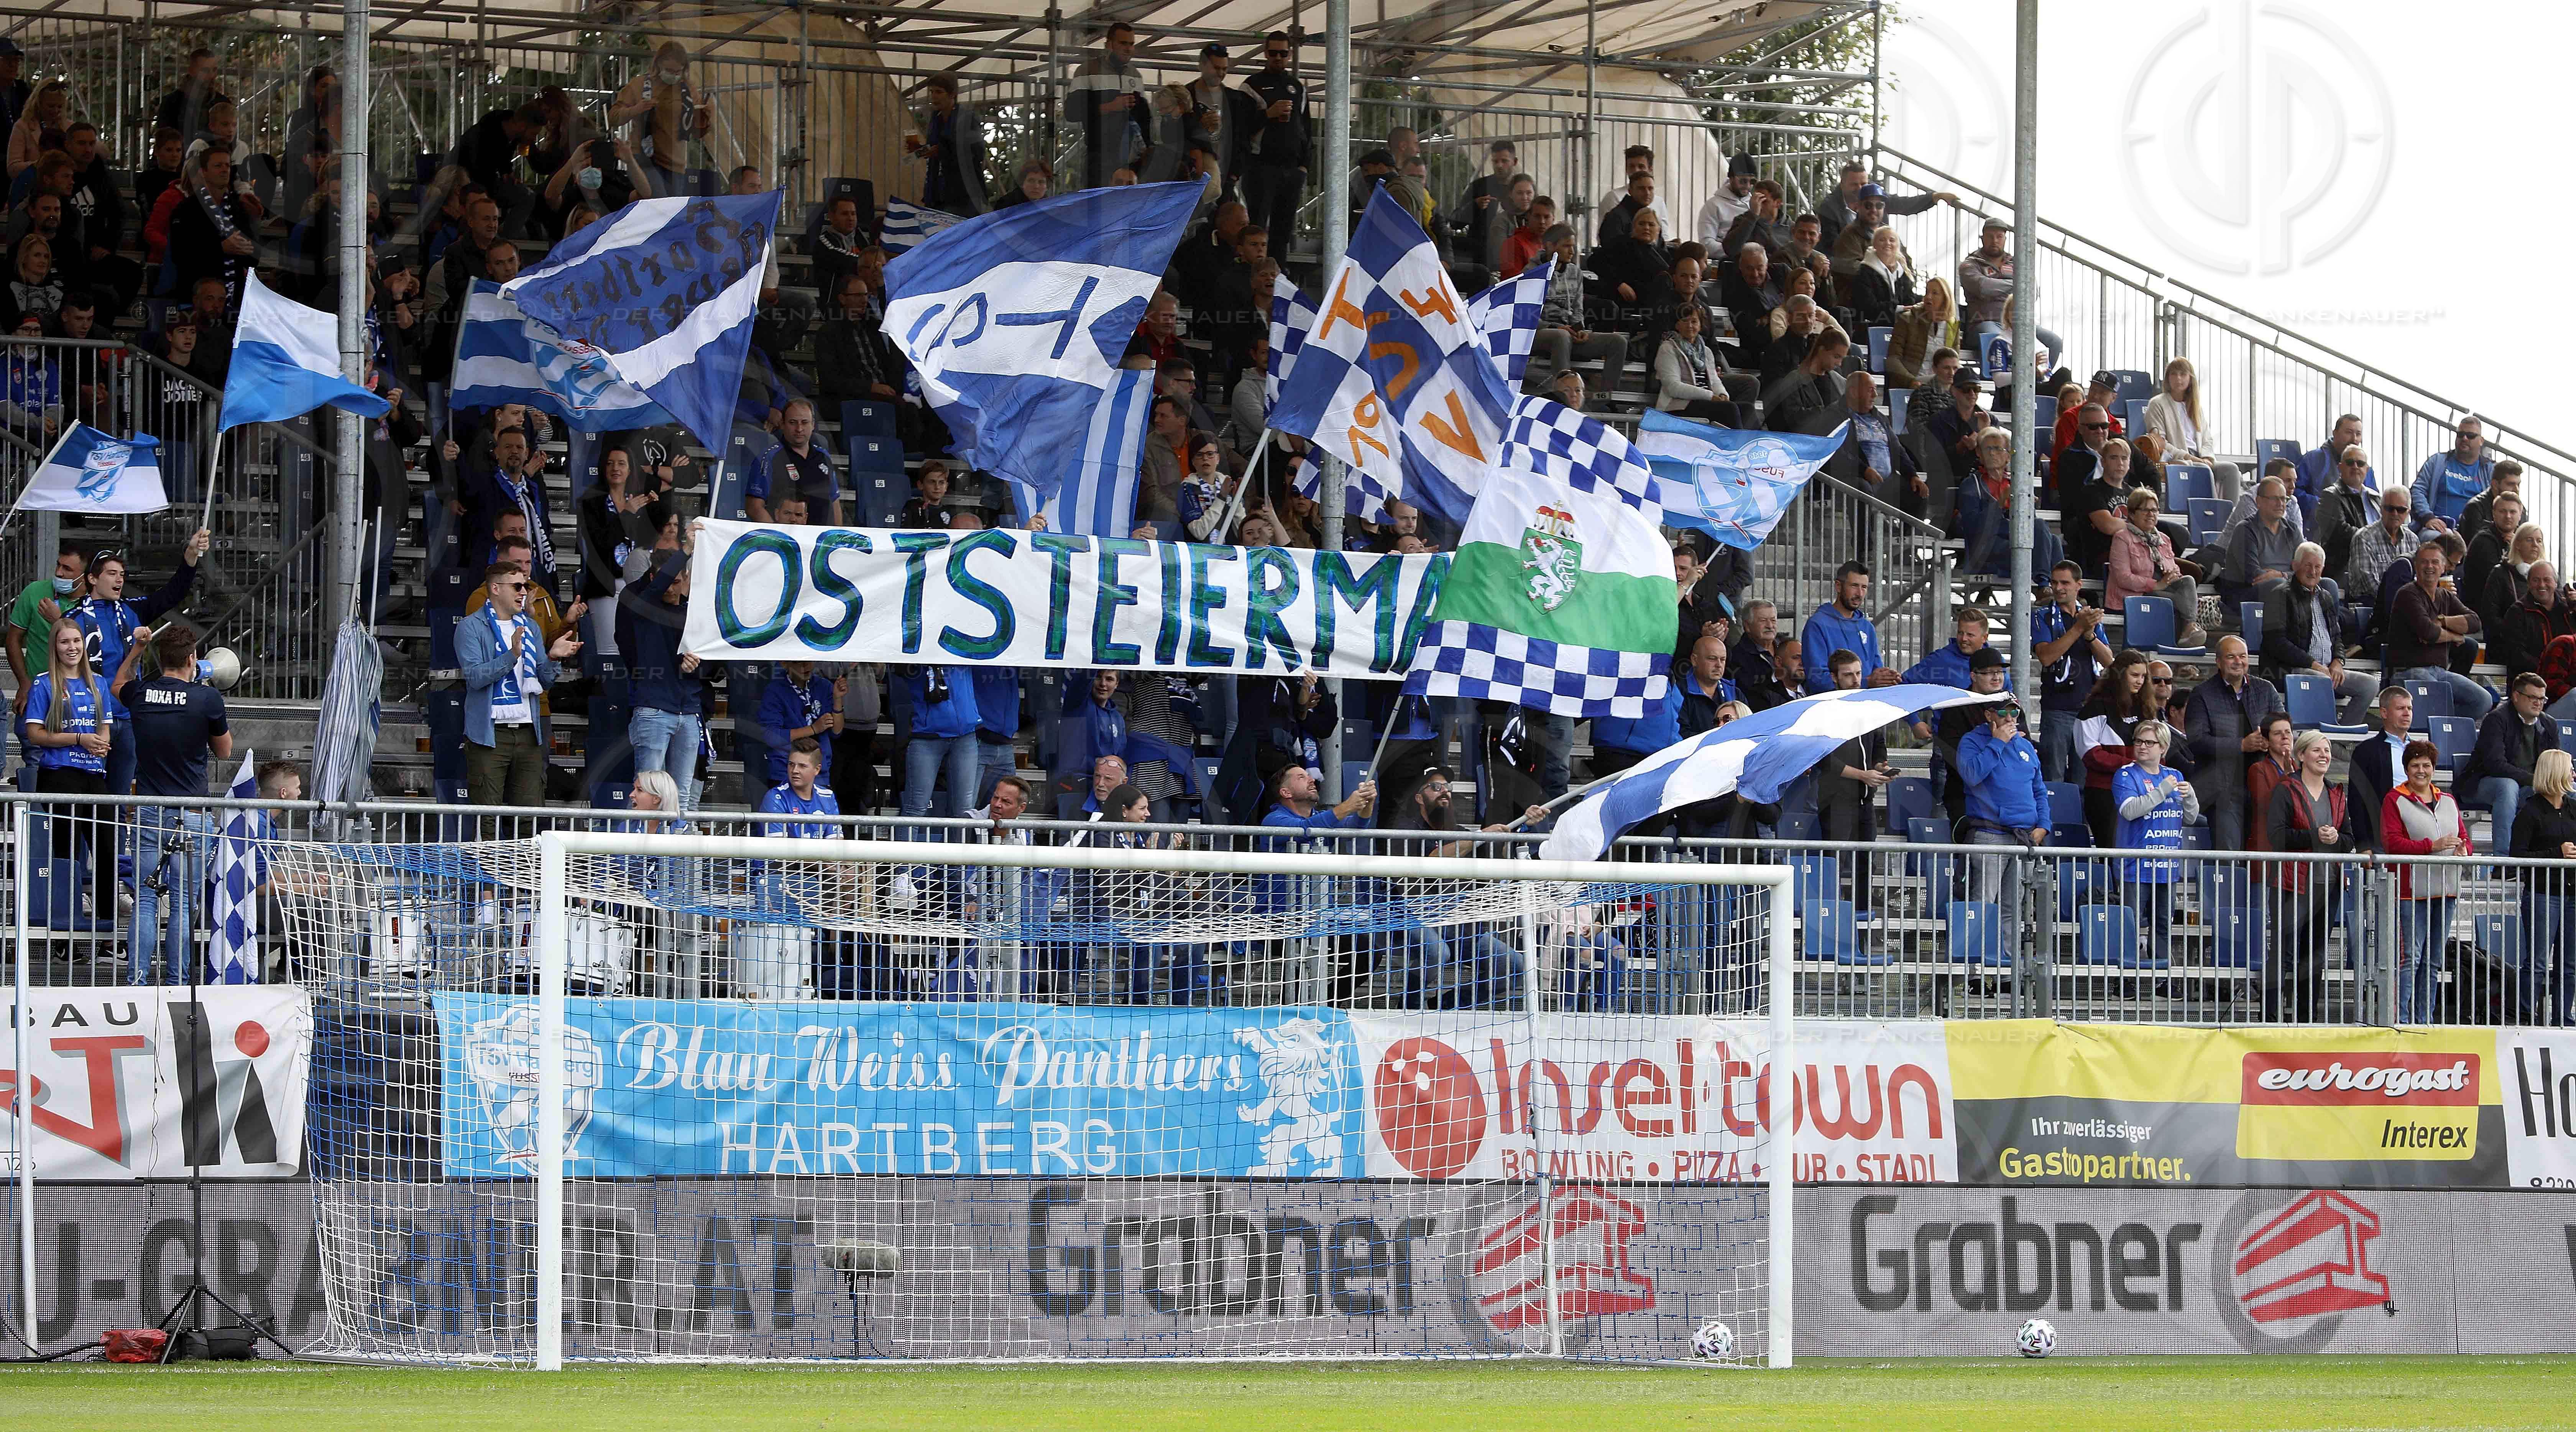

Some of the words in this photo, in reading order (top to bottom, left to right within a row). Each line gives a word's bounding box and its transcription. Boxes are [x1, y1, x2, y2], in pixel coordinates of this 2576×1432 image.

[2445, 468, 2472, 482] Reebok
[145, 689, 172, 704] DOXA
[174, 691, 187, 705] FC
[2563, 727, 2571, 735] 76
[517, 1044, 594, 1079] Haerg
[617, 1022, 777, 1092] Blau
[792, 1025, 960, 1092] Weiss
[981, 1025, 1252, 1106] Panthers
[2258, 1060, 2469, 1097] eurogast
[2032, 1117, 2060, 1137] Ihr
[2381, 1119, 2468, 1148] Interex
[721, 1118, 1116, 1176] HARTBERG
[1502, 1149, 1634, 1181] BOWLING
[1856, 1153, 1944, 1183] STADL
[1027, 1183, 1437, 1318] Grabner
[1850, 1195, 2202, 1312] Grabner
